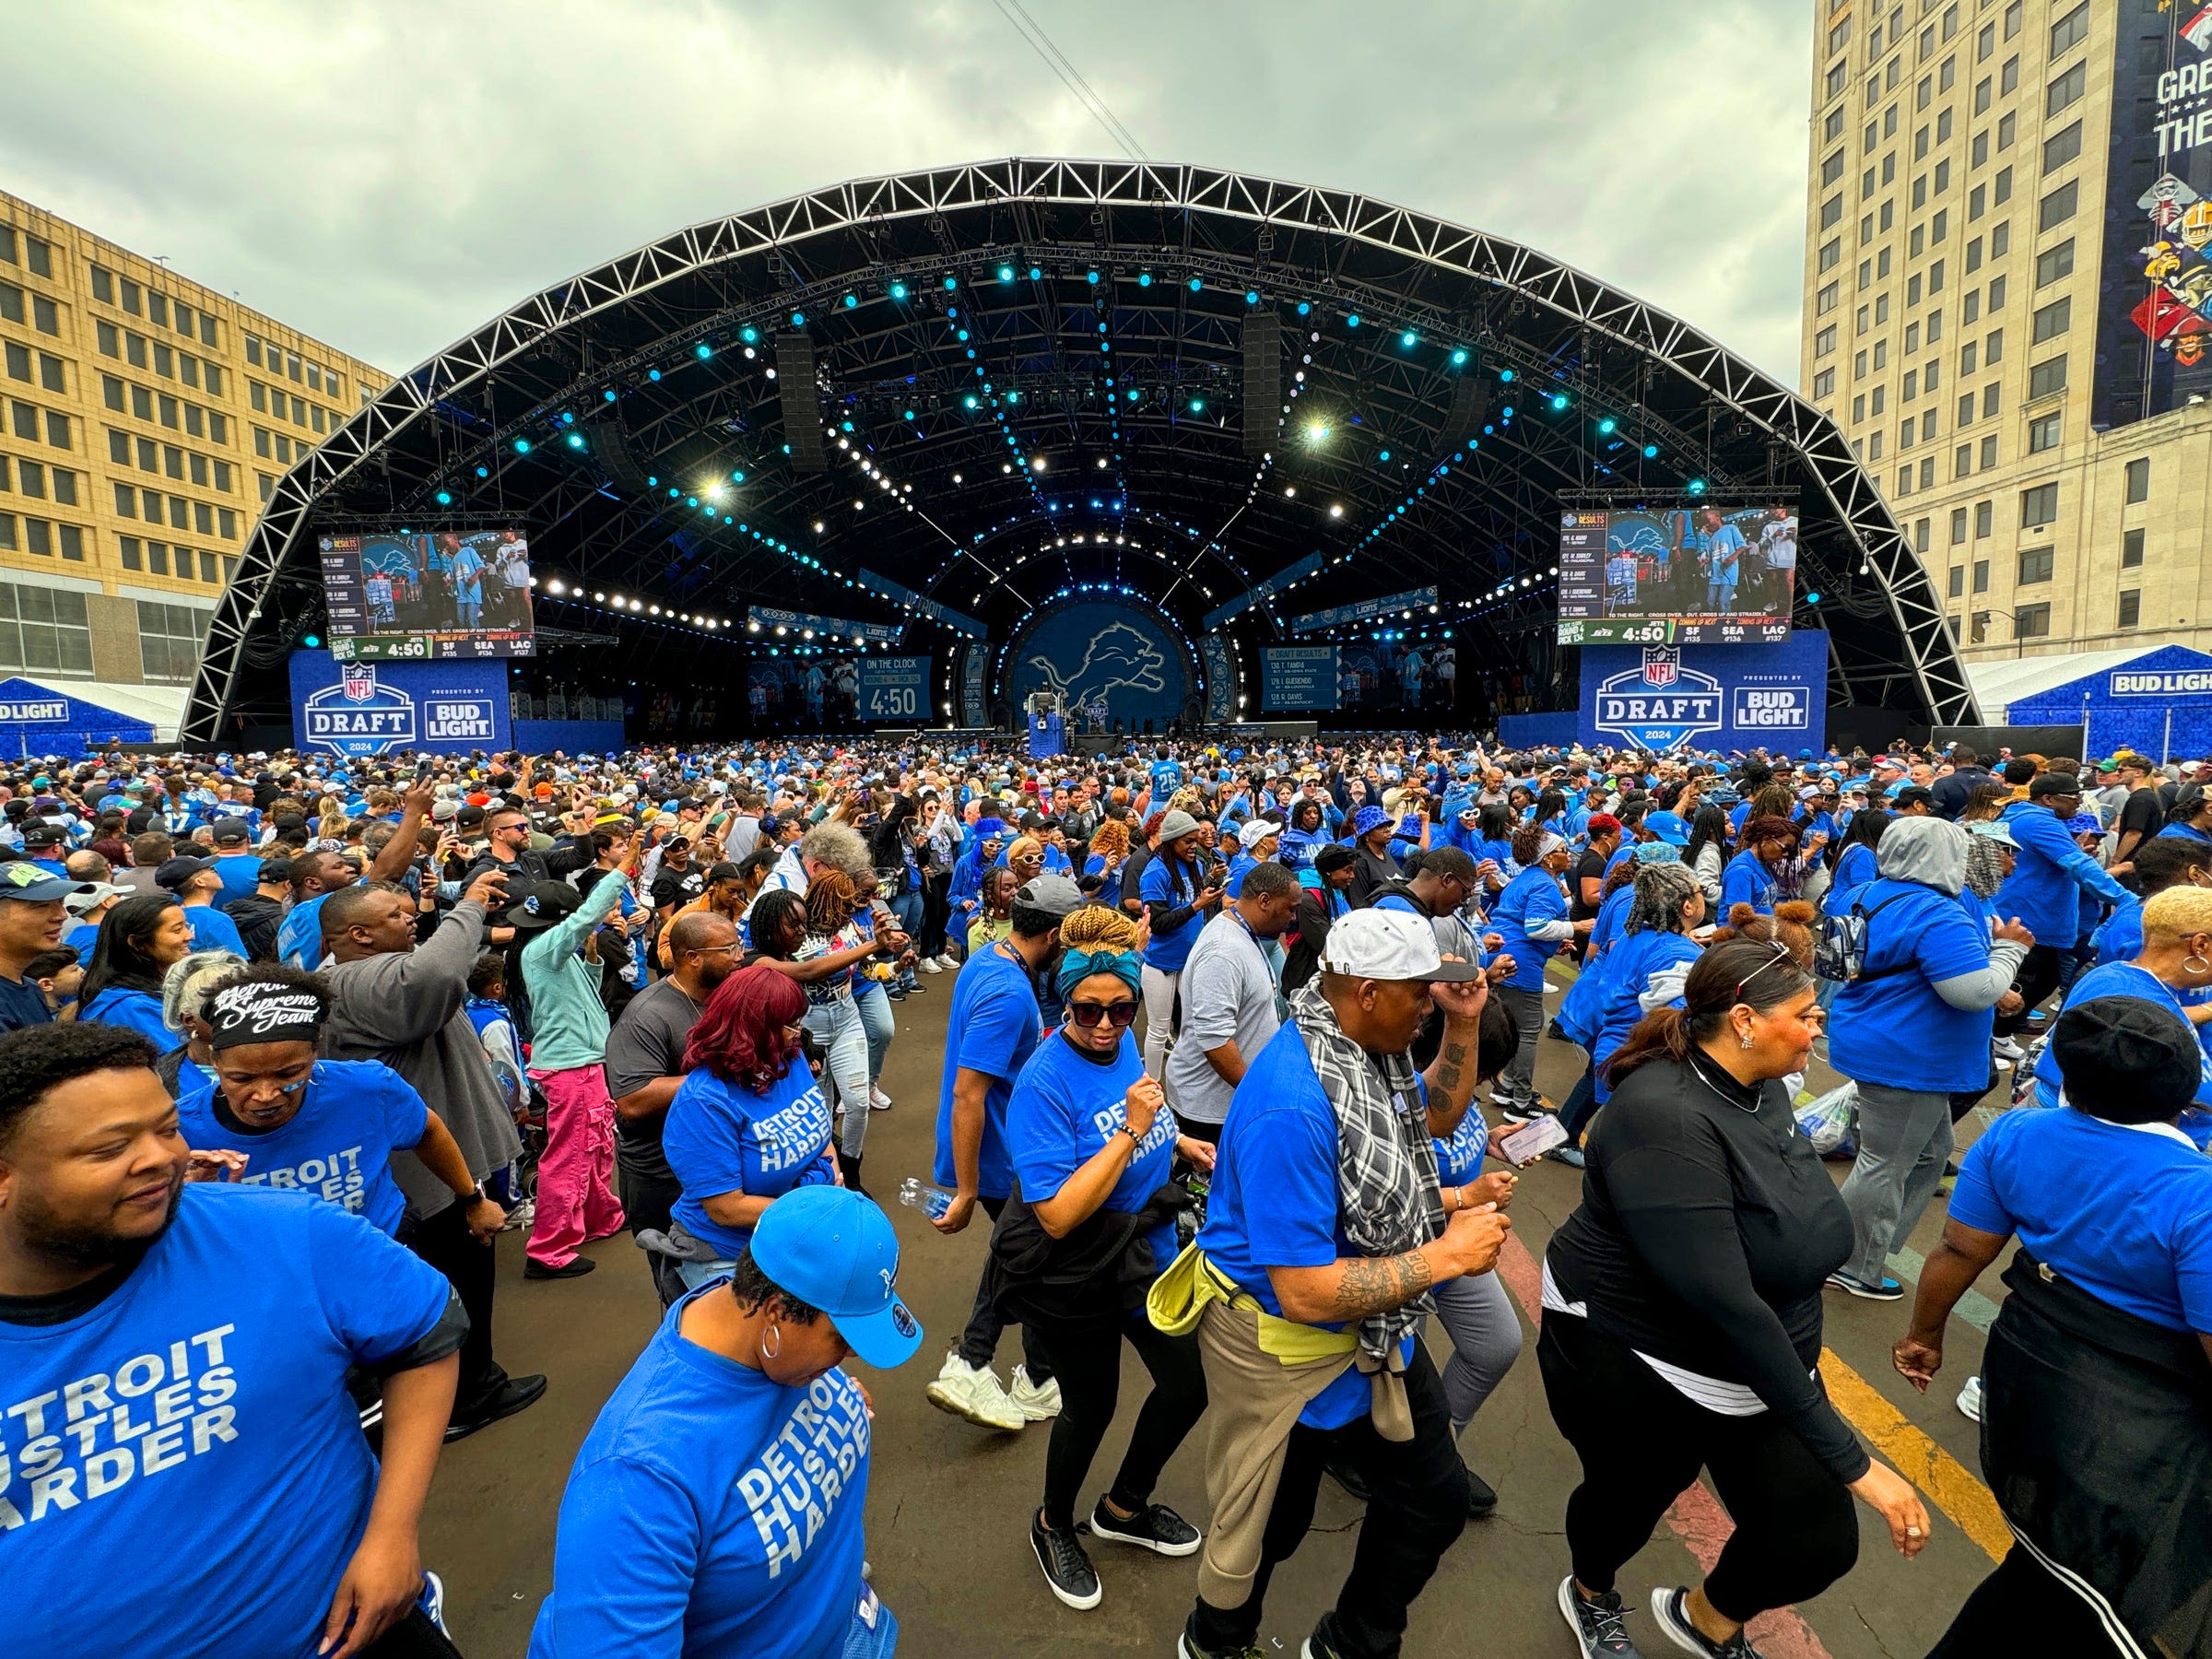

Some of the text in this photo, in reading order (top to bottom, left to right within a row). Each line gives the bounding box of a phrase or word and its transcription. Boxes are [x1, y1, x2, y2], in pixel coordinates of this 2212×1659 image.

[2153, 109, 2212, 158] THE
[1356, 603, 1378, 615] LIONS
[865, 627, 888, 637] LIONS
[1622, 627, 1665, 641] 4:50
[1686, 627, 1700, 635] SF
[1722, 627, 1745, 635] SEA
[1762, 626, 1787, 635] LAC
[388, 643, 425, 657] 4:50
[442, 642, 455, 651] SF
[475, 641, 495, 650] SEA
[511, 641, 532, 650] LAC
[1297, 650, 1323, 658] RESULTS
[867, 659, 917, 670] ON THE CLOCK
[1648, 664, 1674, 683] NFL
[347, 680, 371, 699] NFL
[2115, 676, 2161, 692] BUD
[870, 688, 916, 715] 4:50
[1747, 692, 1795, 709] BUD
[12, 704, 64, 719] LIGHT
[437, 705, 481, 721] BUD
[1606, 700, 1712, 720] DRAFT
[1738, 708, 1804, 725] LIGHT
[314, 713, 406, 733] DRAFT
[429, 721, 490, 736] LIGHT
[1645, 731, 1671, 739] 2024
[349, 742, 372, 752] 2024
[221, 995, 318, 1030] Supreme
[253, 1006, 320, 1033] Team
[752, 1085, 825, 1141] DETROIT
[0, 1323, 236, 1440] TROIT
